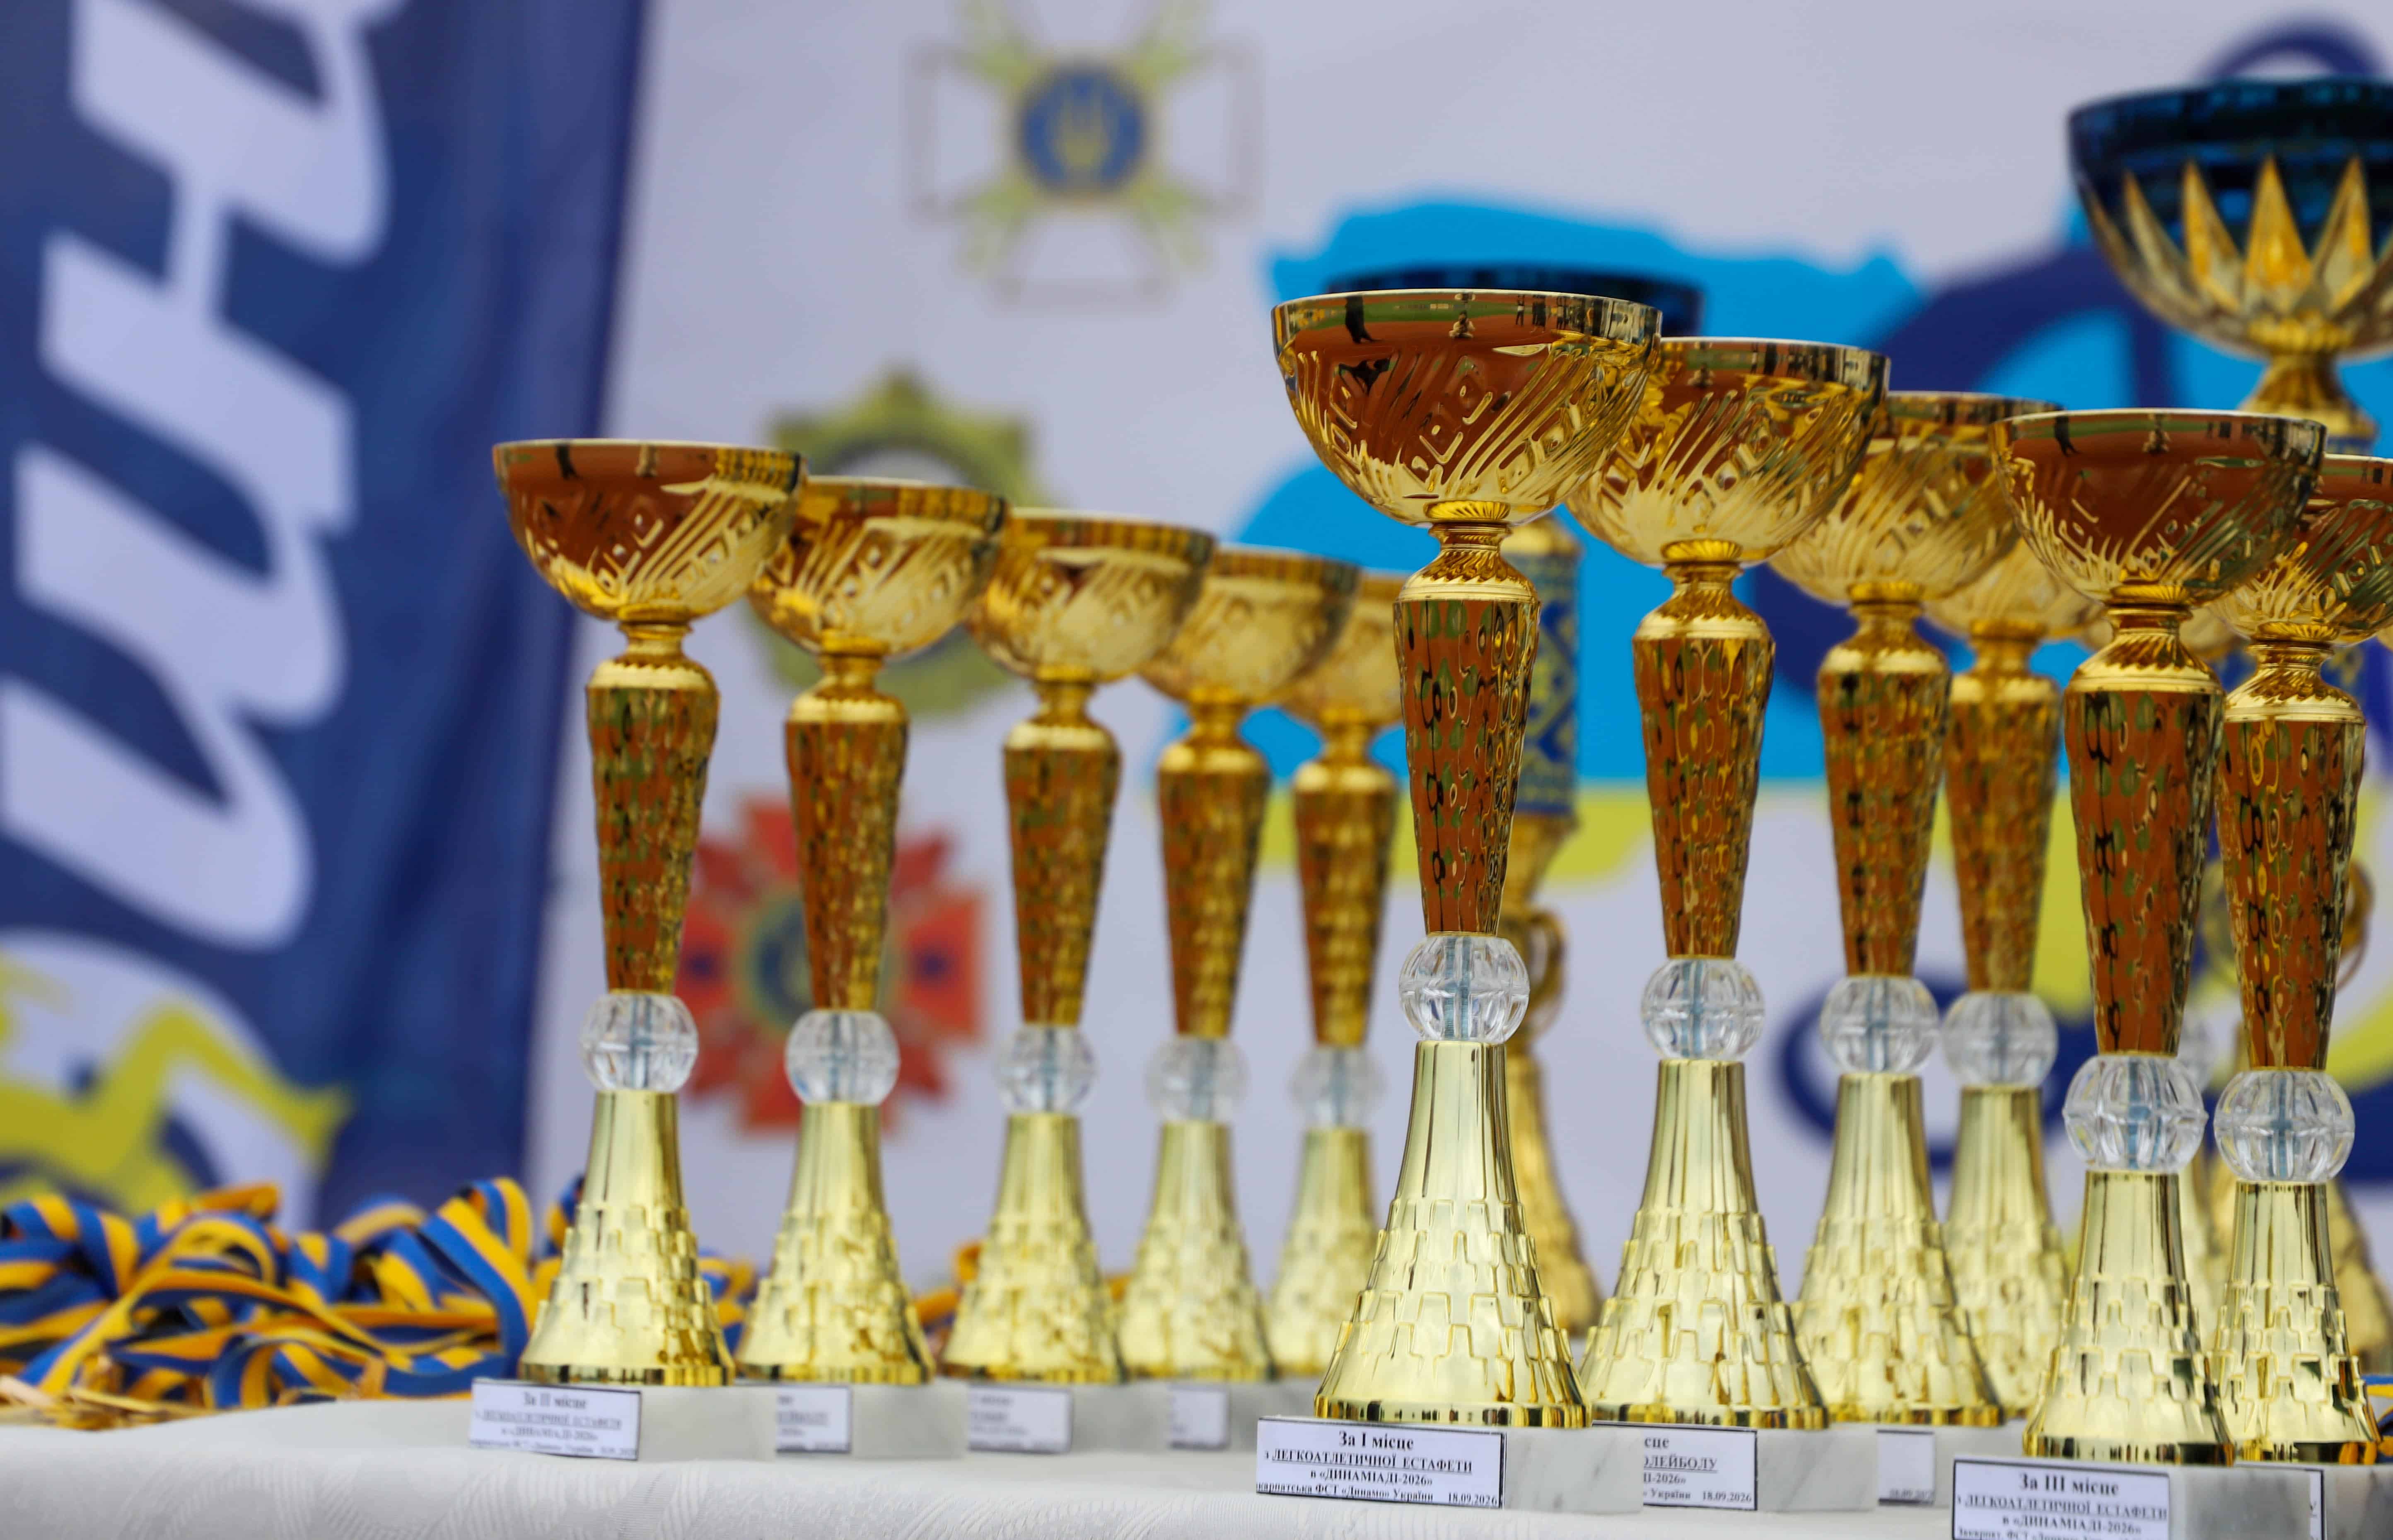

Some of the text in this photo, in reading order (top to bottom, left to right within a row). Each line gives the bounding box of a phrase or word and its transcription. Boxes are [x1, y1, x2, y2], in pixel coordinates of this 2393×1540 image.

[1339, 1431, 1355, 1446] За
[1372, 1433, 1414, 1451] місце
[1272, 1448, 1396, 1468] ЛЕГКОАТЛЕТИЧНОЇ
[1403, 1457, 1472, 1472] ЕСТАФЕТИ
[1315, 1483, 1339, 1495] ФСТ
[1393, 1489, 1433, 1502] України
[1448, 1492, 1497, 1506] 18.09.2026
[2020, 1473, 2038, 1489] За
[2072, 1477, 2119, 1496] місце
